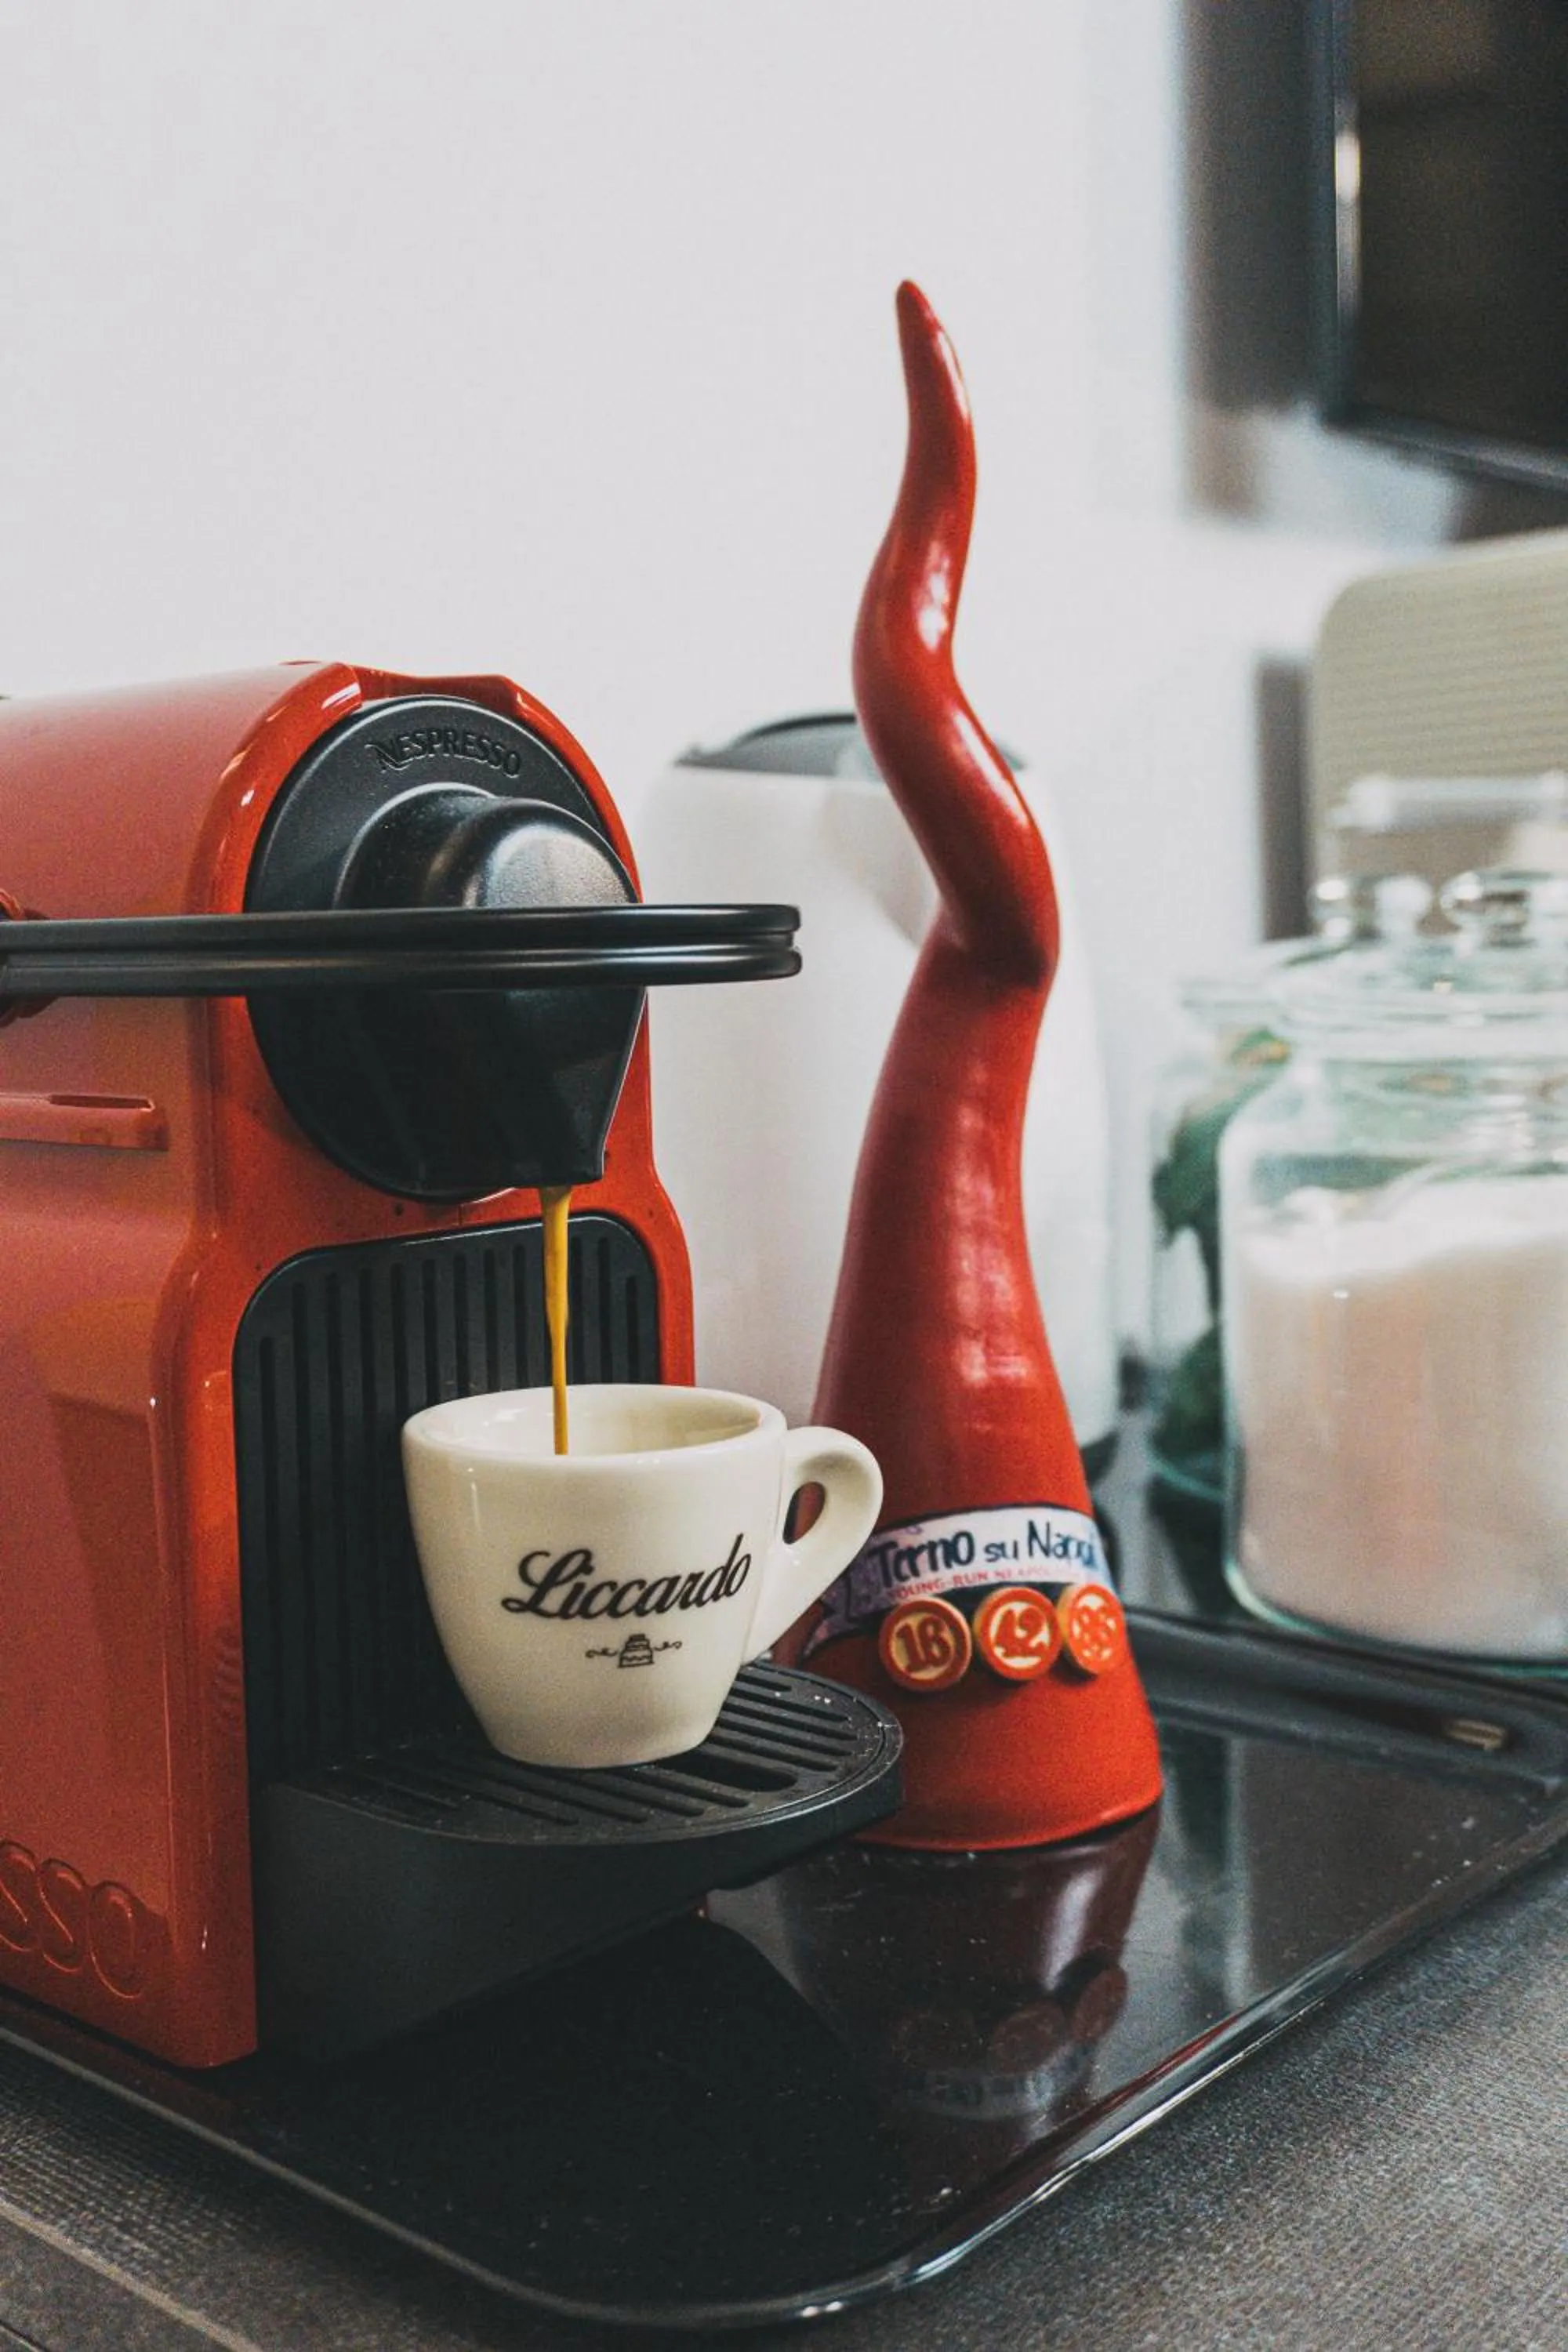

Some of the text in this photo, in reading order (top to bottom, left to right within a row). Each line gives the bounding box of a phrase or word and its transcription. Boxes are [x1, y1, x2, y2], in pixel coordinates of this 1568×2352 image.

[364, 726, 522, 779] NESPRESSO
[501, 1532, 752, 1621] Liccardo
[983, 1539, 1019, 1563] su
[895, 1615, 951, 1671] 18
